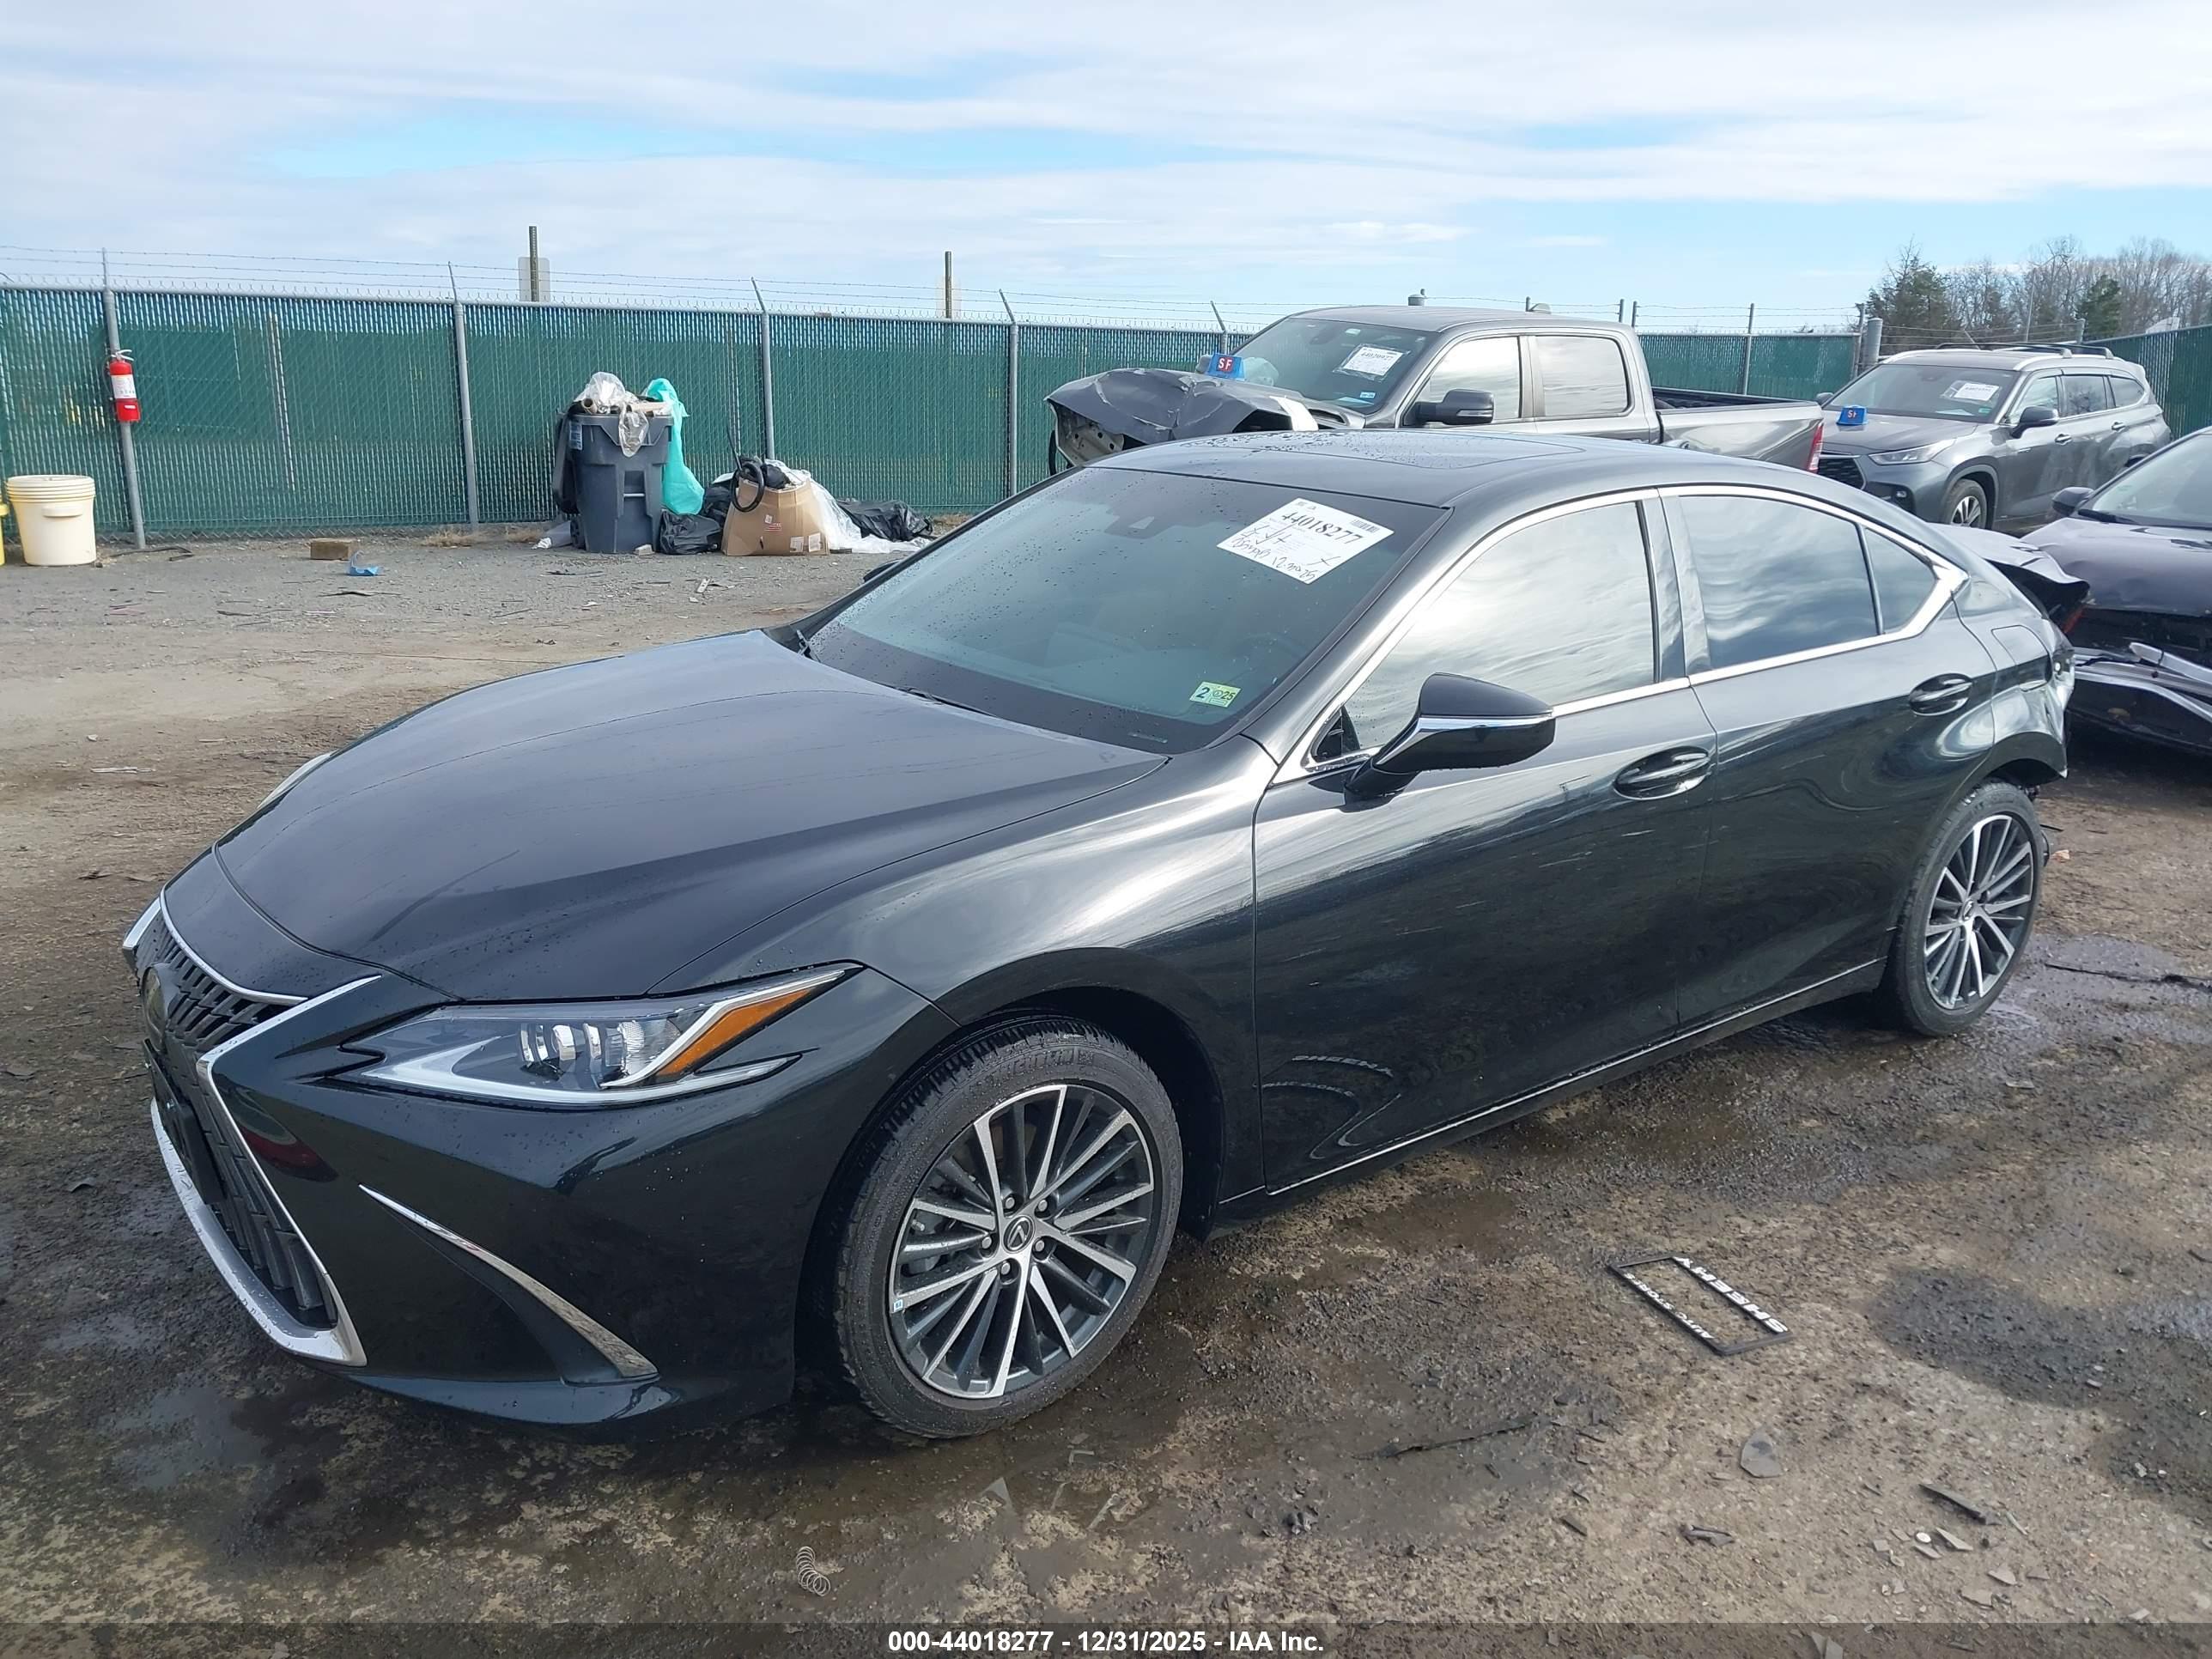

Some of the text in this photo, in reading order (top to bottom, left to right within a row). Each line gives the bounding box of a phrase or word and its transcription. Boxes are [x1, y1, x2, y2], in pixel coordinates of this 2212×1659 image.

[1218, 357, 1233, 370] SF
[1281, 511, 1364, 544] 44018277
[1196, 687, 1237, 701] 2 25
[1673, 1256, 1789, 1333] SHEEHY
[1674, 1311, 1716, 1340] AUTO
